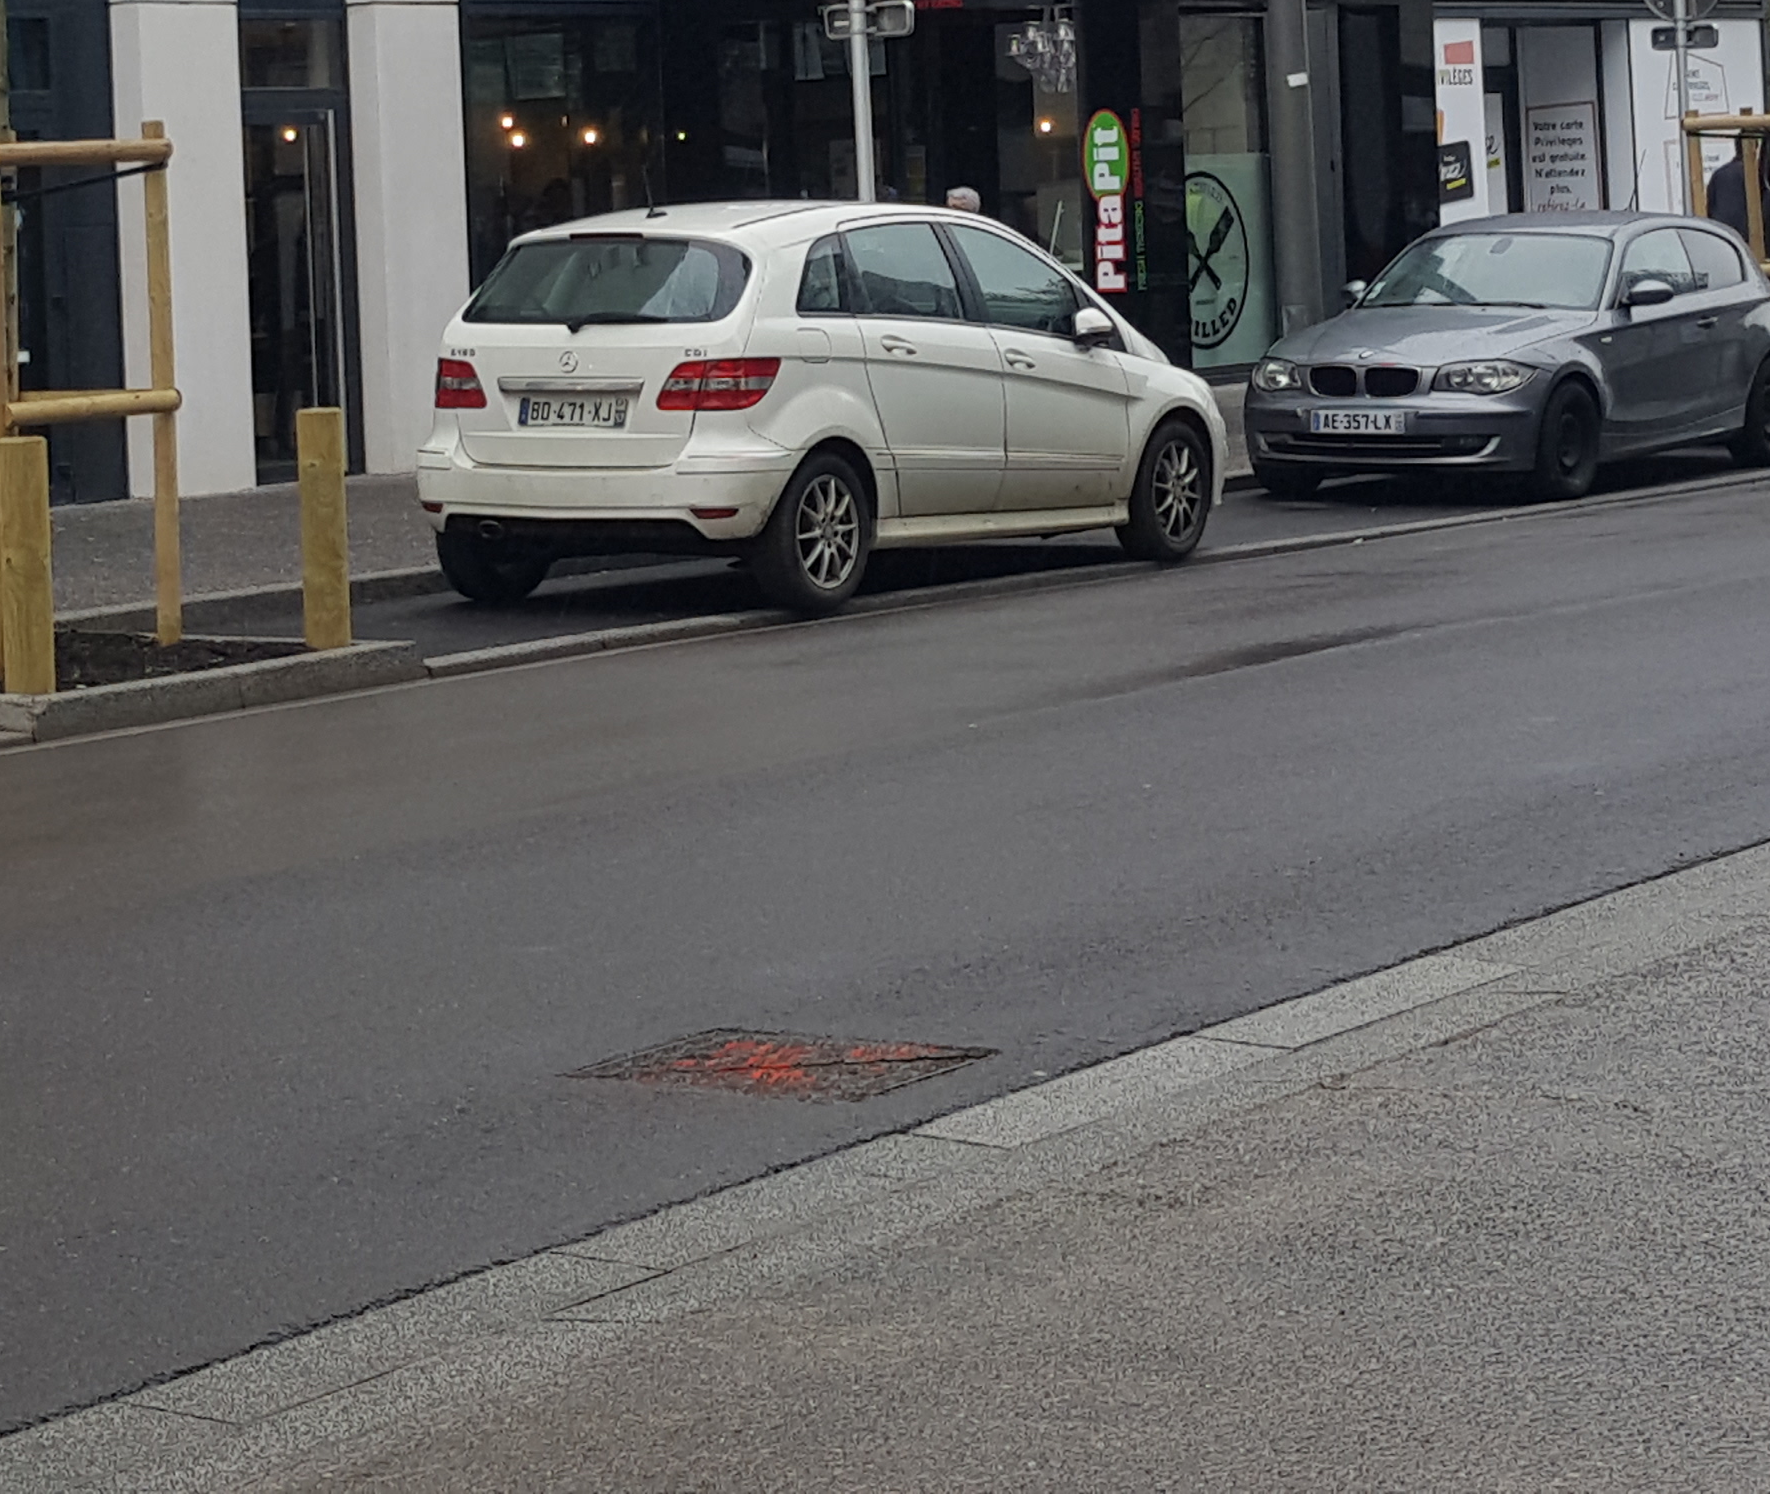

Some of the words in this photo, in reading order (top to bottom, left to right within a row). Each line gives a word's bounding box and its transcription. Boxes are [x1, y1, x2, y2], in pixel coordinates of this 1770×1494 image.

[1093, 125, 1121, 191] Pit
[1096, 195, 1126, 290] Pita
[684, 348, 708, 357] CDI
[530, 401, 613, 423] BD-471-XJ
[1323, 413, 1392, 430] AE-357-LX
